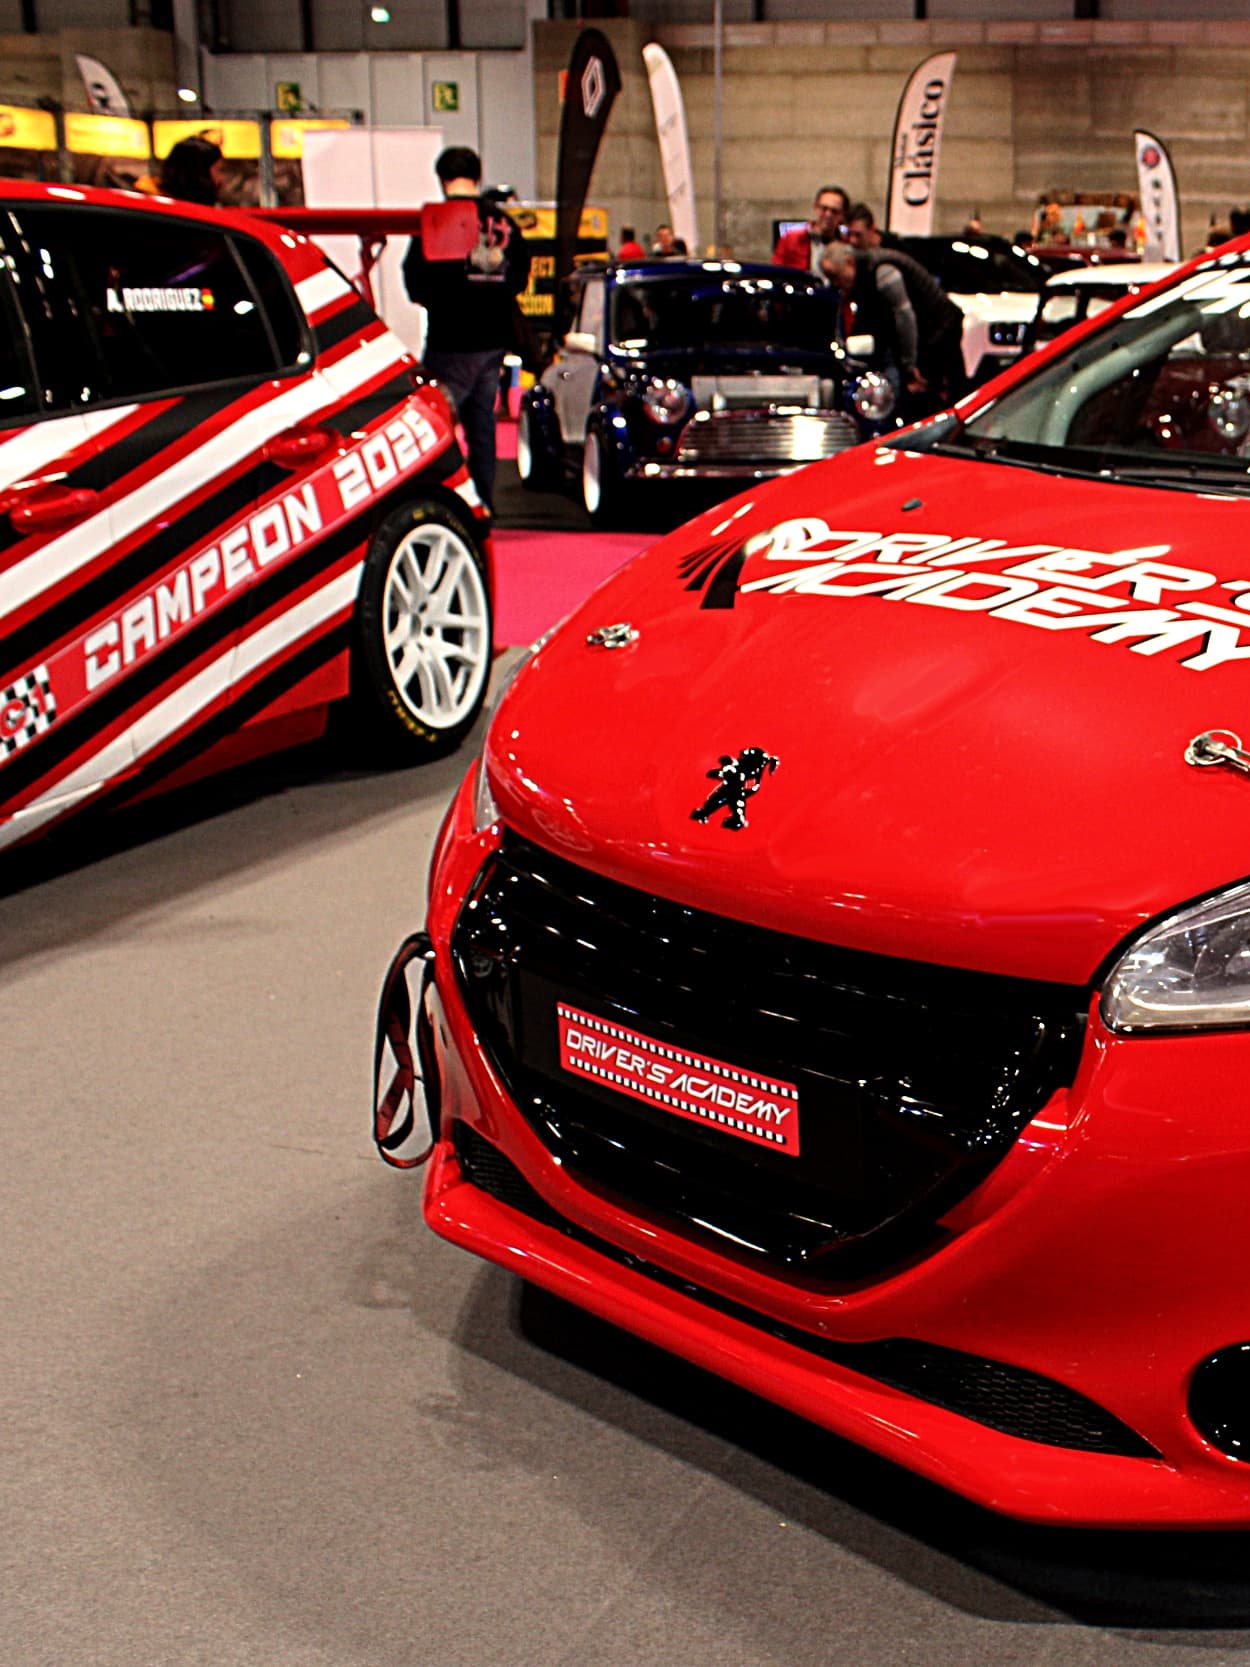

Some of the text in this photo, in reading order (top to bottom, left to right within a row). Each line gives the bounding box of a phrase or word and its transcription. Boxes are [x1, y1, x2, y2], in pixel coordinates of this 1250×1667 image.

[122, 287, 203, 312] RODRIGUEZ
[84, 407, 438, 691] CAMPEON 2025
[566, 1029, 792, 1125] DRIVER'S ACADEMY
